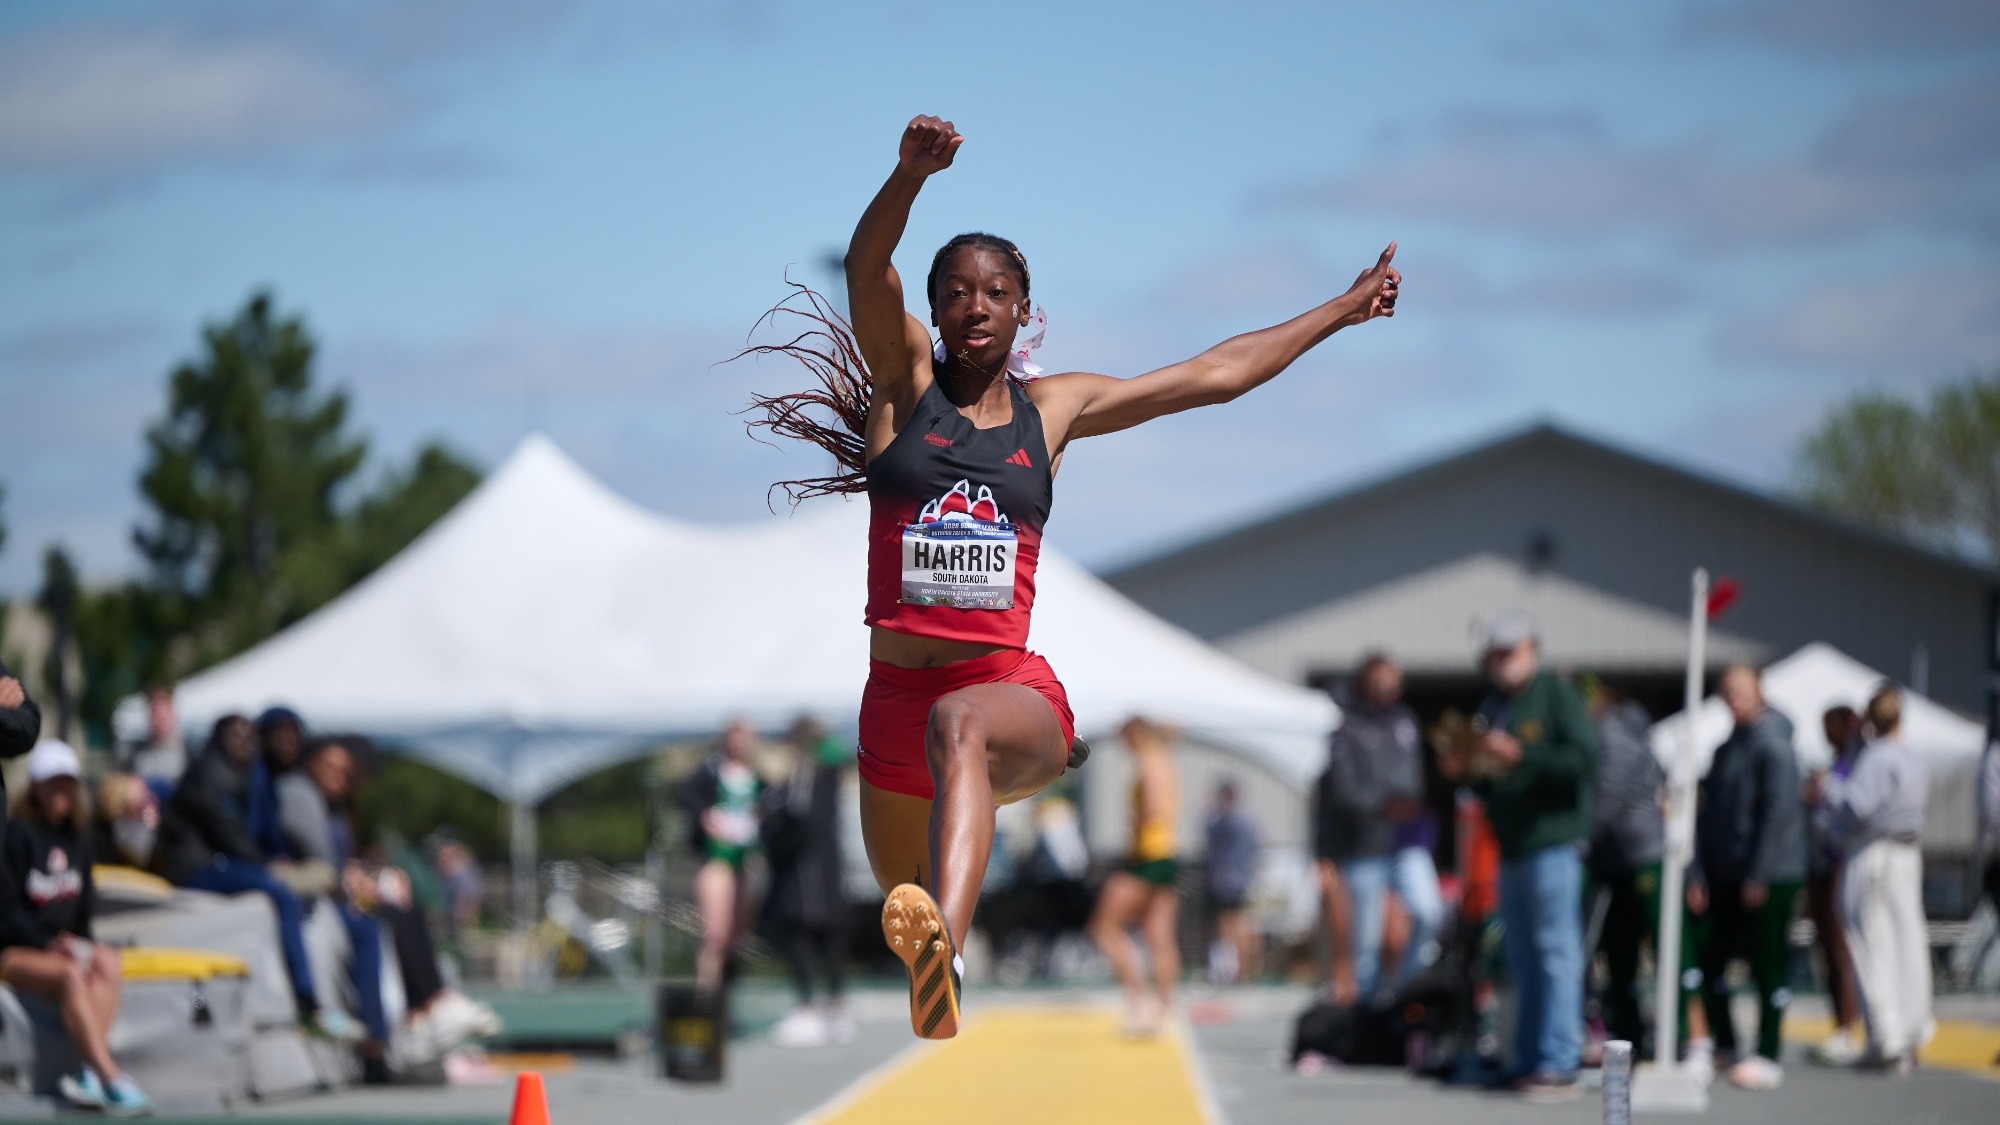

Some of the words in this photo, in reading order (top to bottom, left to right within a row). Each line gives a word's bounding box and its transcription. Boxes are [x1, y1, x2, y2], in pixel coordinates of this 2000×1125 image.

[914, 541, 1006, 573] HARRIS
[932, 572, 957, 584] SOUTH
[959, 574, 989, 585] DAKOTA
